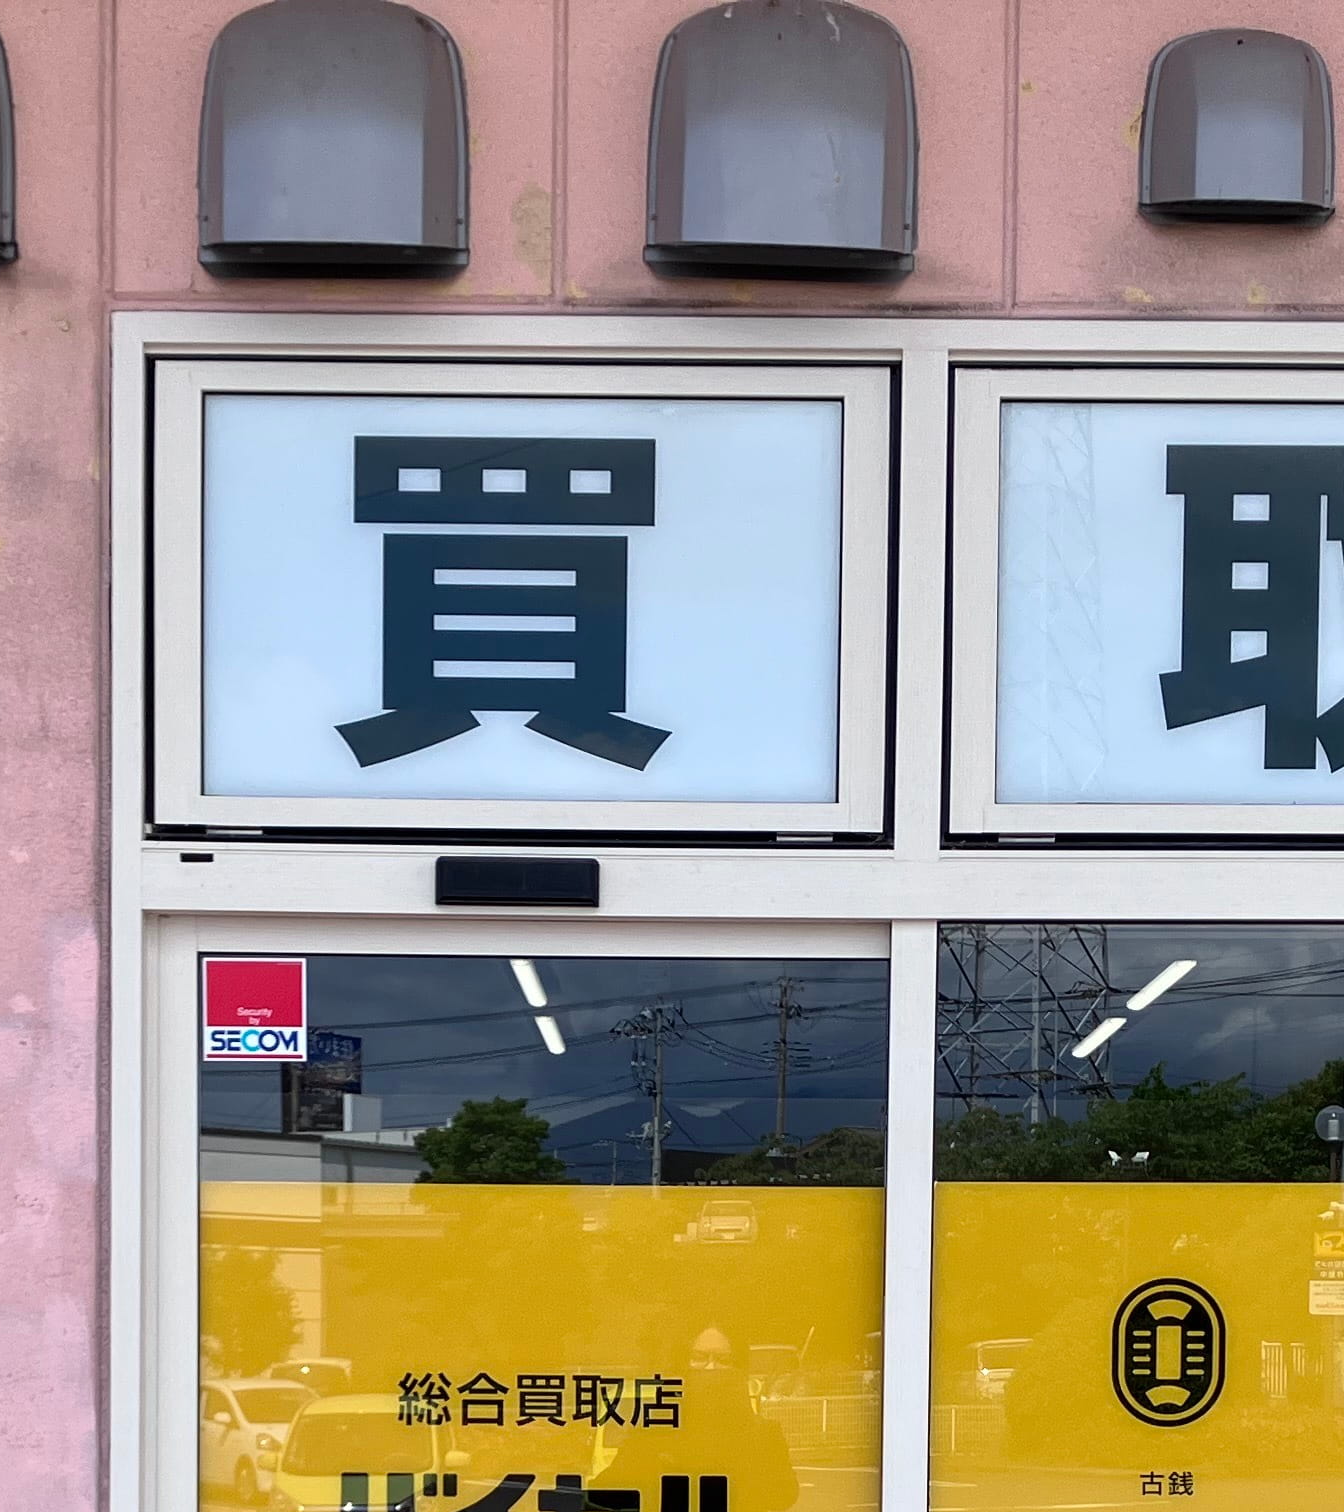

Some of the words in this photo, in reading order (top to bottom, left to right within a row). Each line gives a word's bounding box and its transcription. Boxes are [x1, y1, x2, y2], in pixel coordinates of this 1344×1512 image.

[236, 1007, 273, 1018] Security
[249, 1017, 260, 1026] by
[211, 1029, 298, 1052] SECOM
[396, 1373, 683, 1429] 総合買取店
[1139, 1471, 1195, 1497] 古銭
